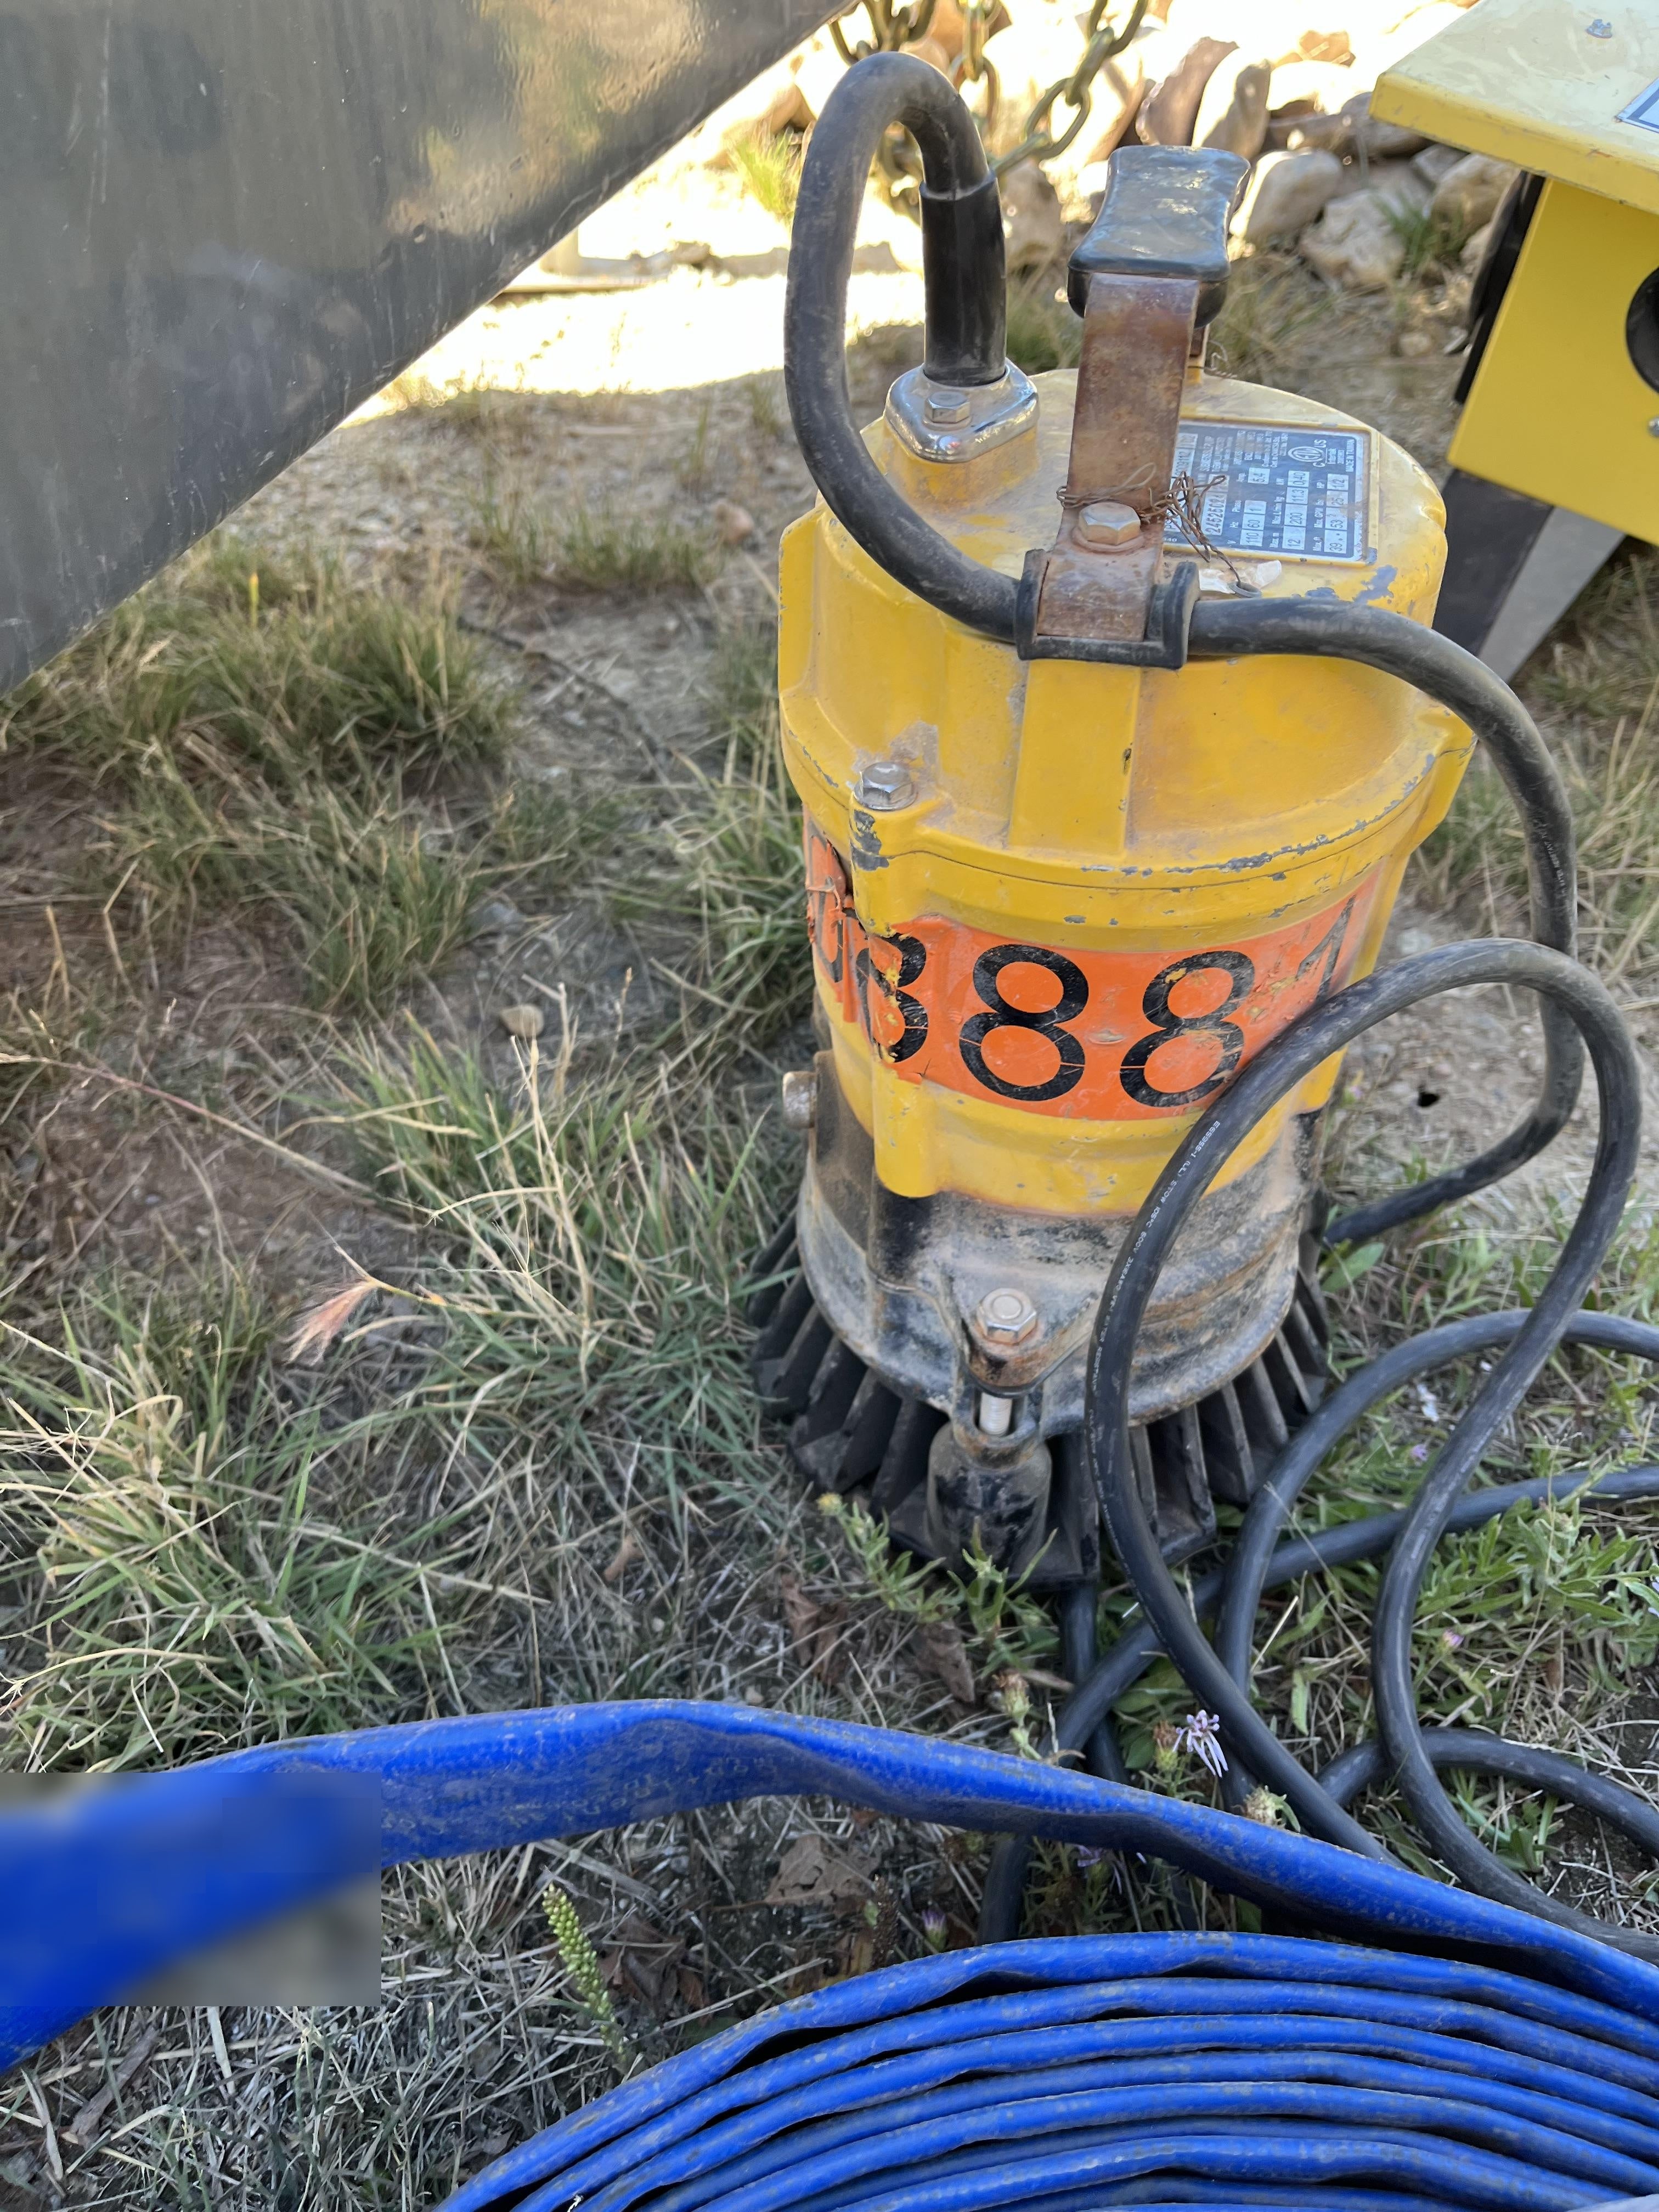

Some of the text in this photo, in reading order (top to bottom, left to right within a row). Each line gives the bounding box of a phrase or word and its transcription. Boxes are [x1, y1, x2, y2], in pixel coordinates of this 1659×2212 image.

[1252, 472, 1266, 482] 5.4
[1333, 479, 1345, 488] 1/2
[1291, 489, 1305, 502] 11.3
[1331, 497, 1344, 505] 25
[1289, 512, 1303, 524] 200
[1247, 520, 1260, 528] 60
[1330, 520, 1344, 528] 53
[1245, 532, 1261, 544] 110
[1288, 538, 1301, 547] 12
[1329, 542, 1342, 552] 39
